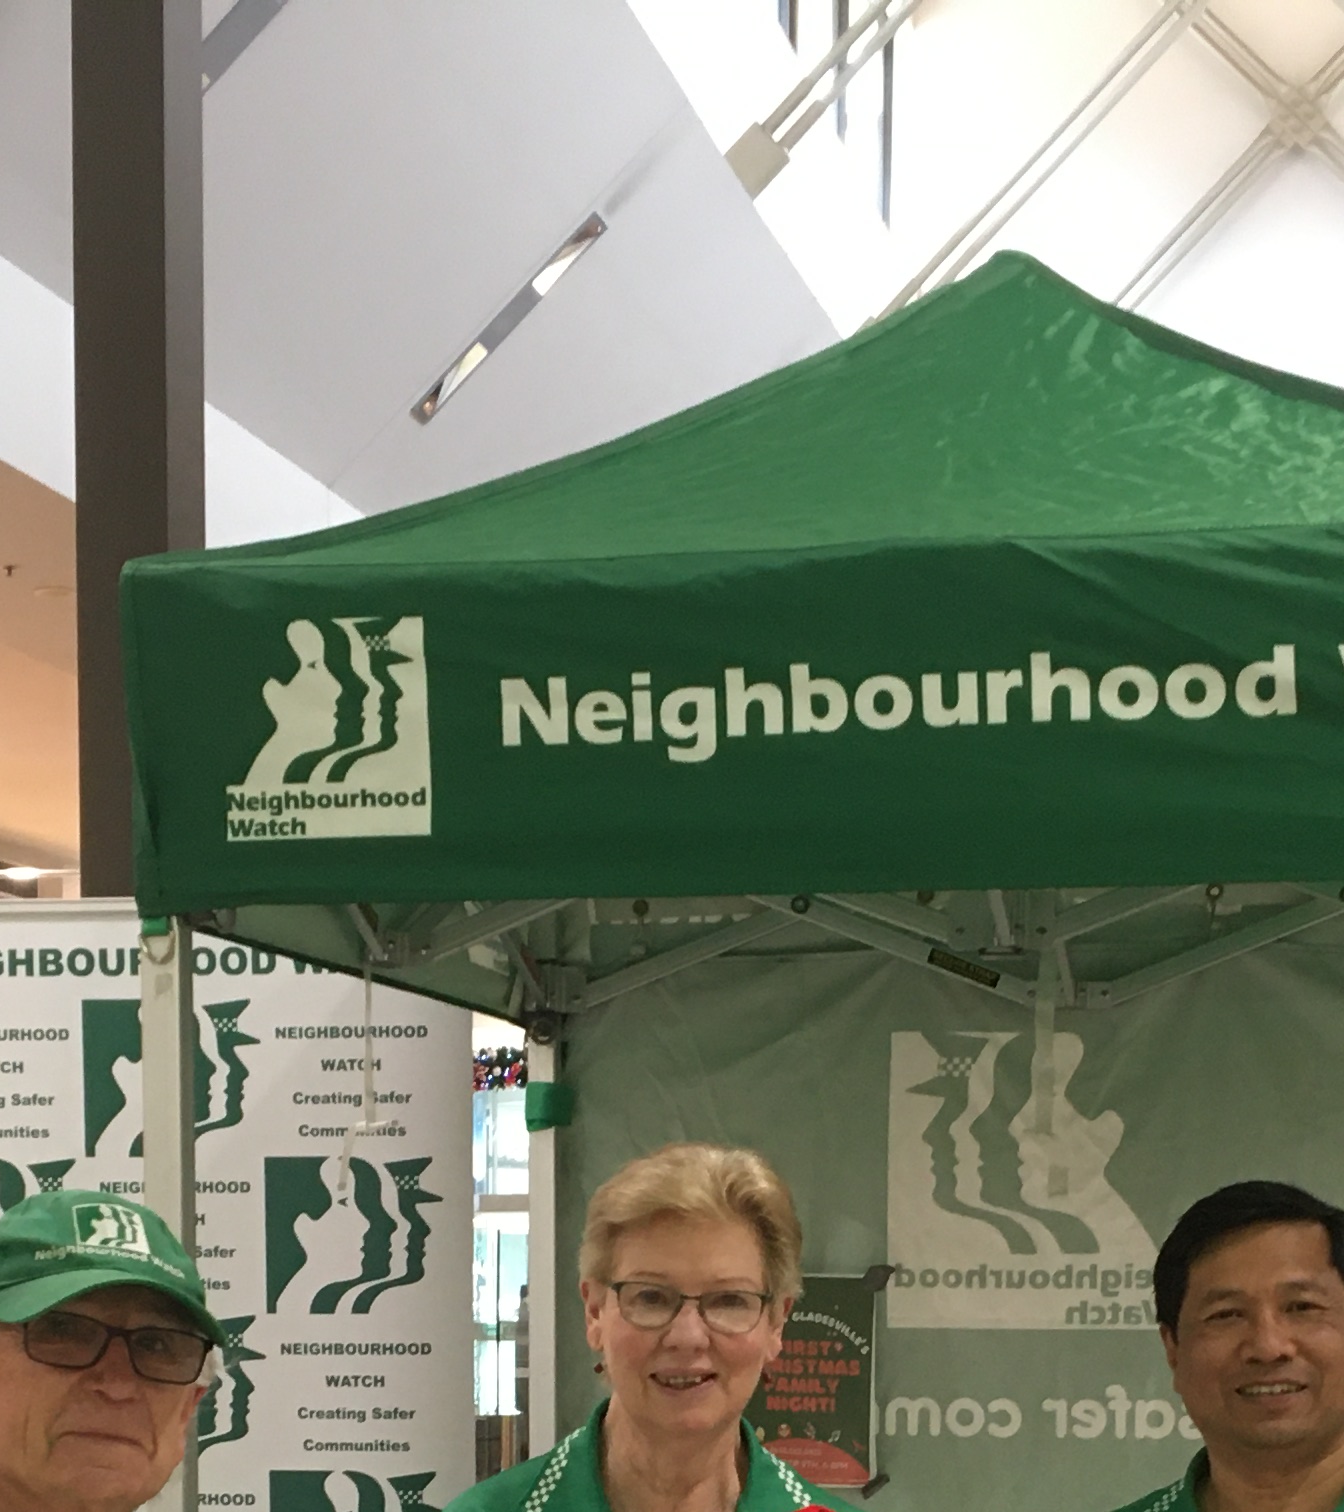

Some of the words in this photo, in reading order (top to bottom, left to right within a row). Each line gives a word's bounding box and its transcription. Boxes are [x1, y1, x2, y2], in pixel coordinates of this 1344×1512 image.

[500, 643, 1297, 763] Neighbourhood
[227, 787, 426, 815] Neighbourhood
[229, 817, 305, 837] Watch
[11, 1094, 55, 1106] Safer
[293, 1092, 362, 1106] Creating
[280, 1342, 432, 1355] NEIGHBOURHOOD
[325, 1375, 385, 1388] WATCH
[766, 1397, 836, 1412] NIGHT!
[297, 1407, 366, 1422] Creating
[372, 1407, 415, 1420] Safer
[303, 1439, 410, 1452] Communities
